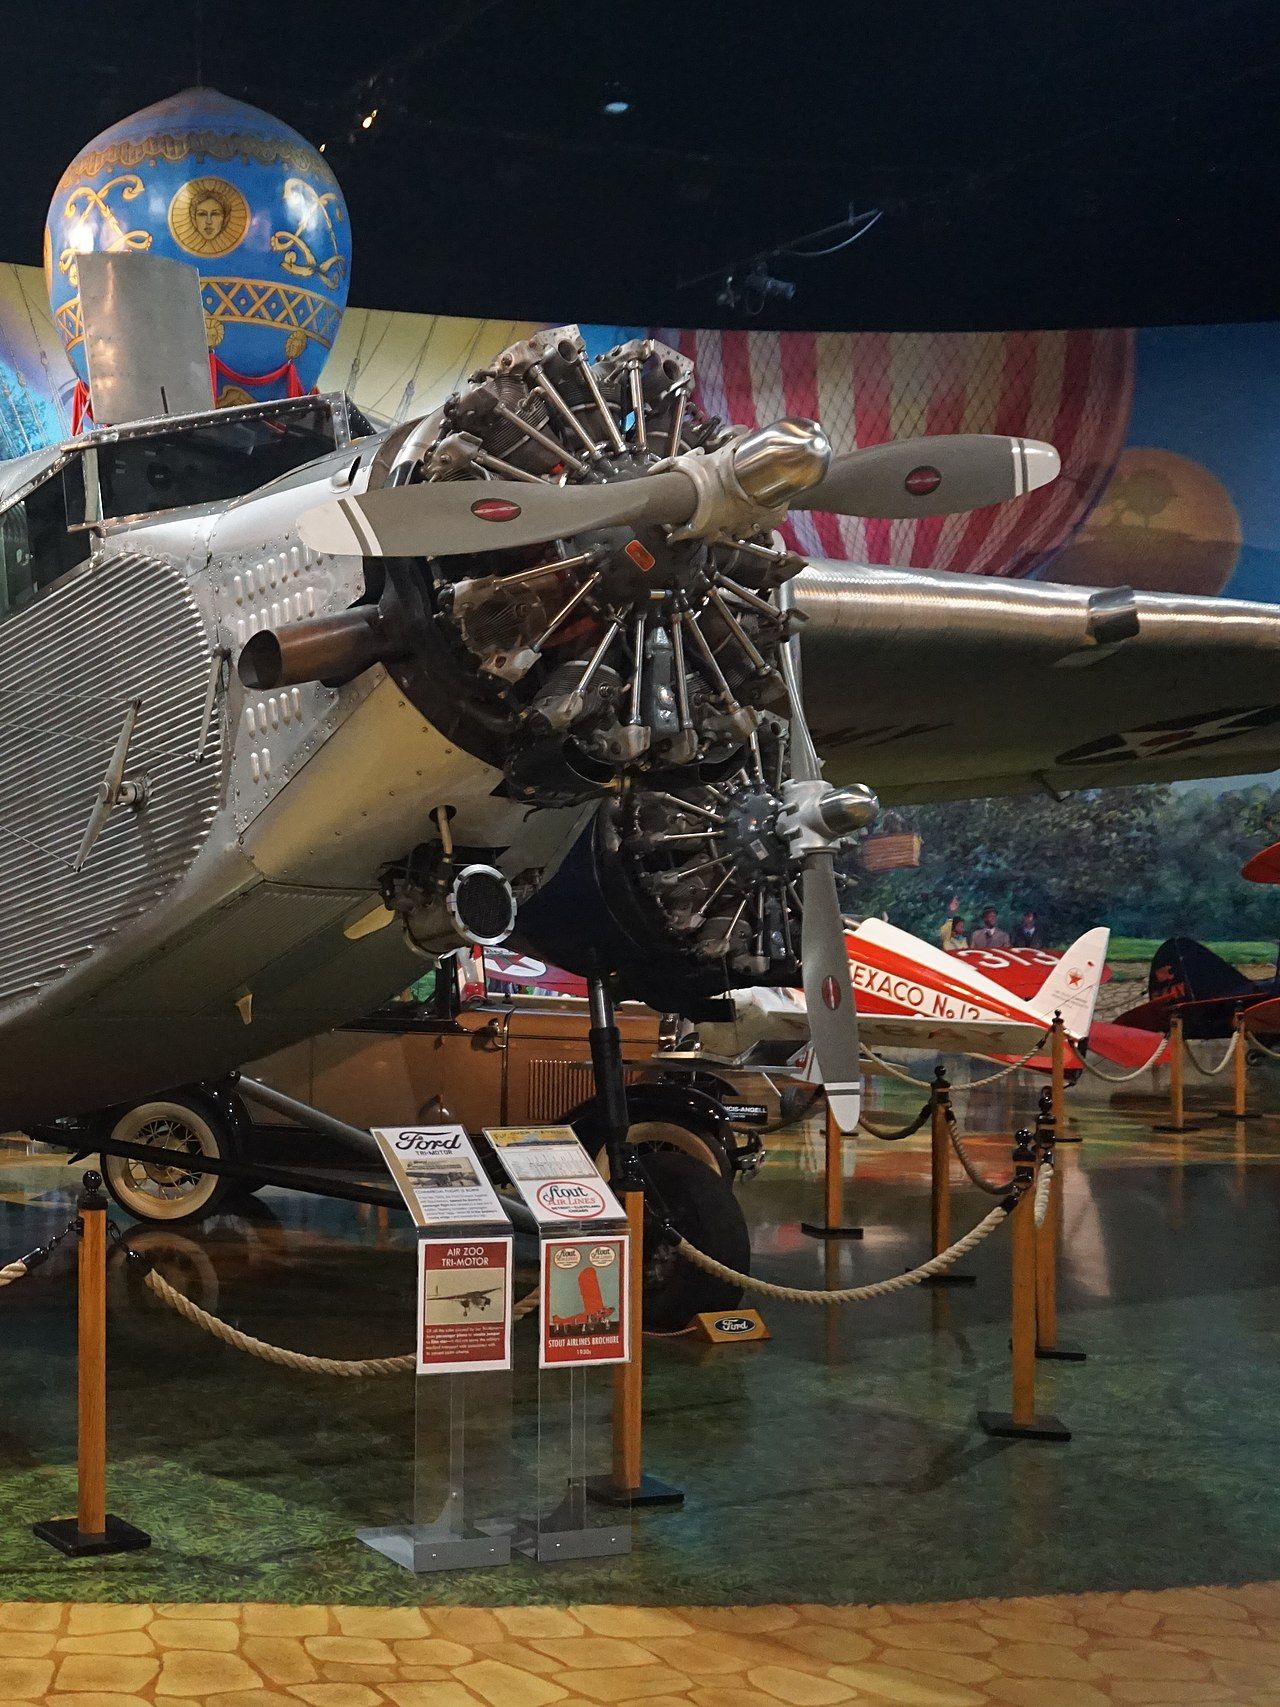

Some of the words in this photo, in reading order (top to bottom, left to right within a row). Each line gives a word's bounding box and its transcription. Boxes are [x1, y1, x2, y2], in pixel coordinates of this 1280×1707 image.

[723, 1105, 768, 1114] NCIS-ANGELL
[395, 1131, 462, 1150] Ford
[543, 1185, 588, 1201] Stout
[447, 1247, 461, 1256] AIR
[463, 1246, 484, 1256] ZOO
[442, 1257, 489, 1267] TRI-MOTOR
[722, 1319, 749, 1331] Ford
[548, 1339, 566, 1348] STOUT
[567, 1338, 591, 1346] AIRLINES
[592, 1336, 619, 1345] BROCHURE
